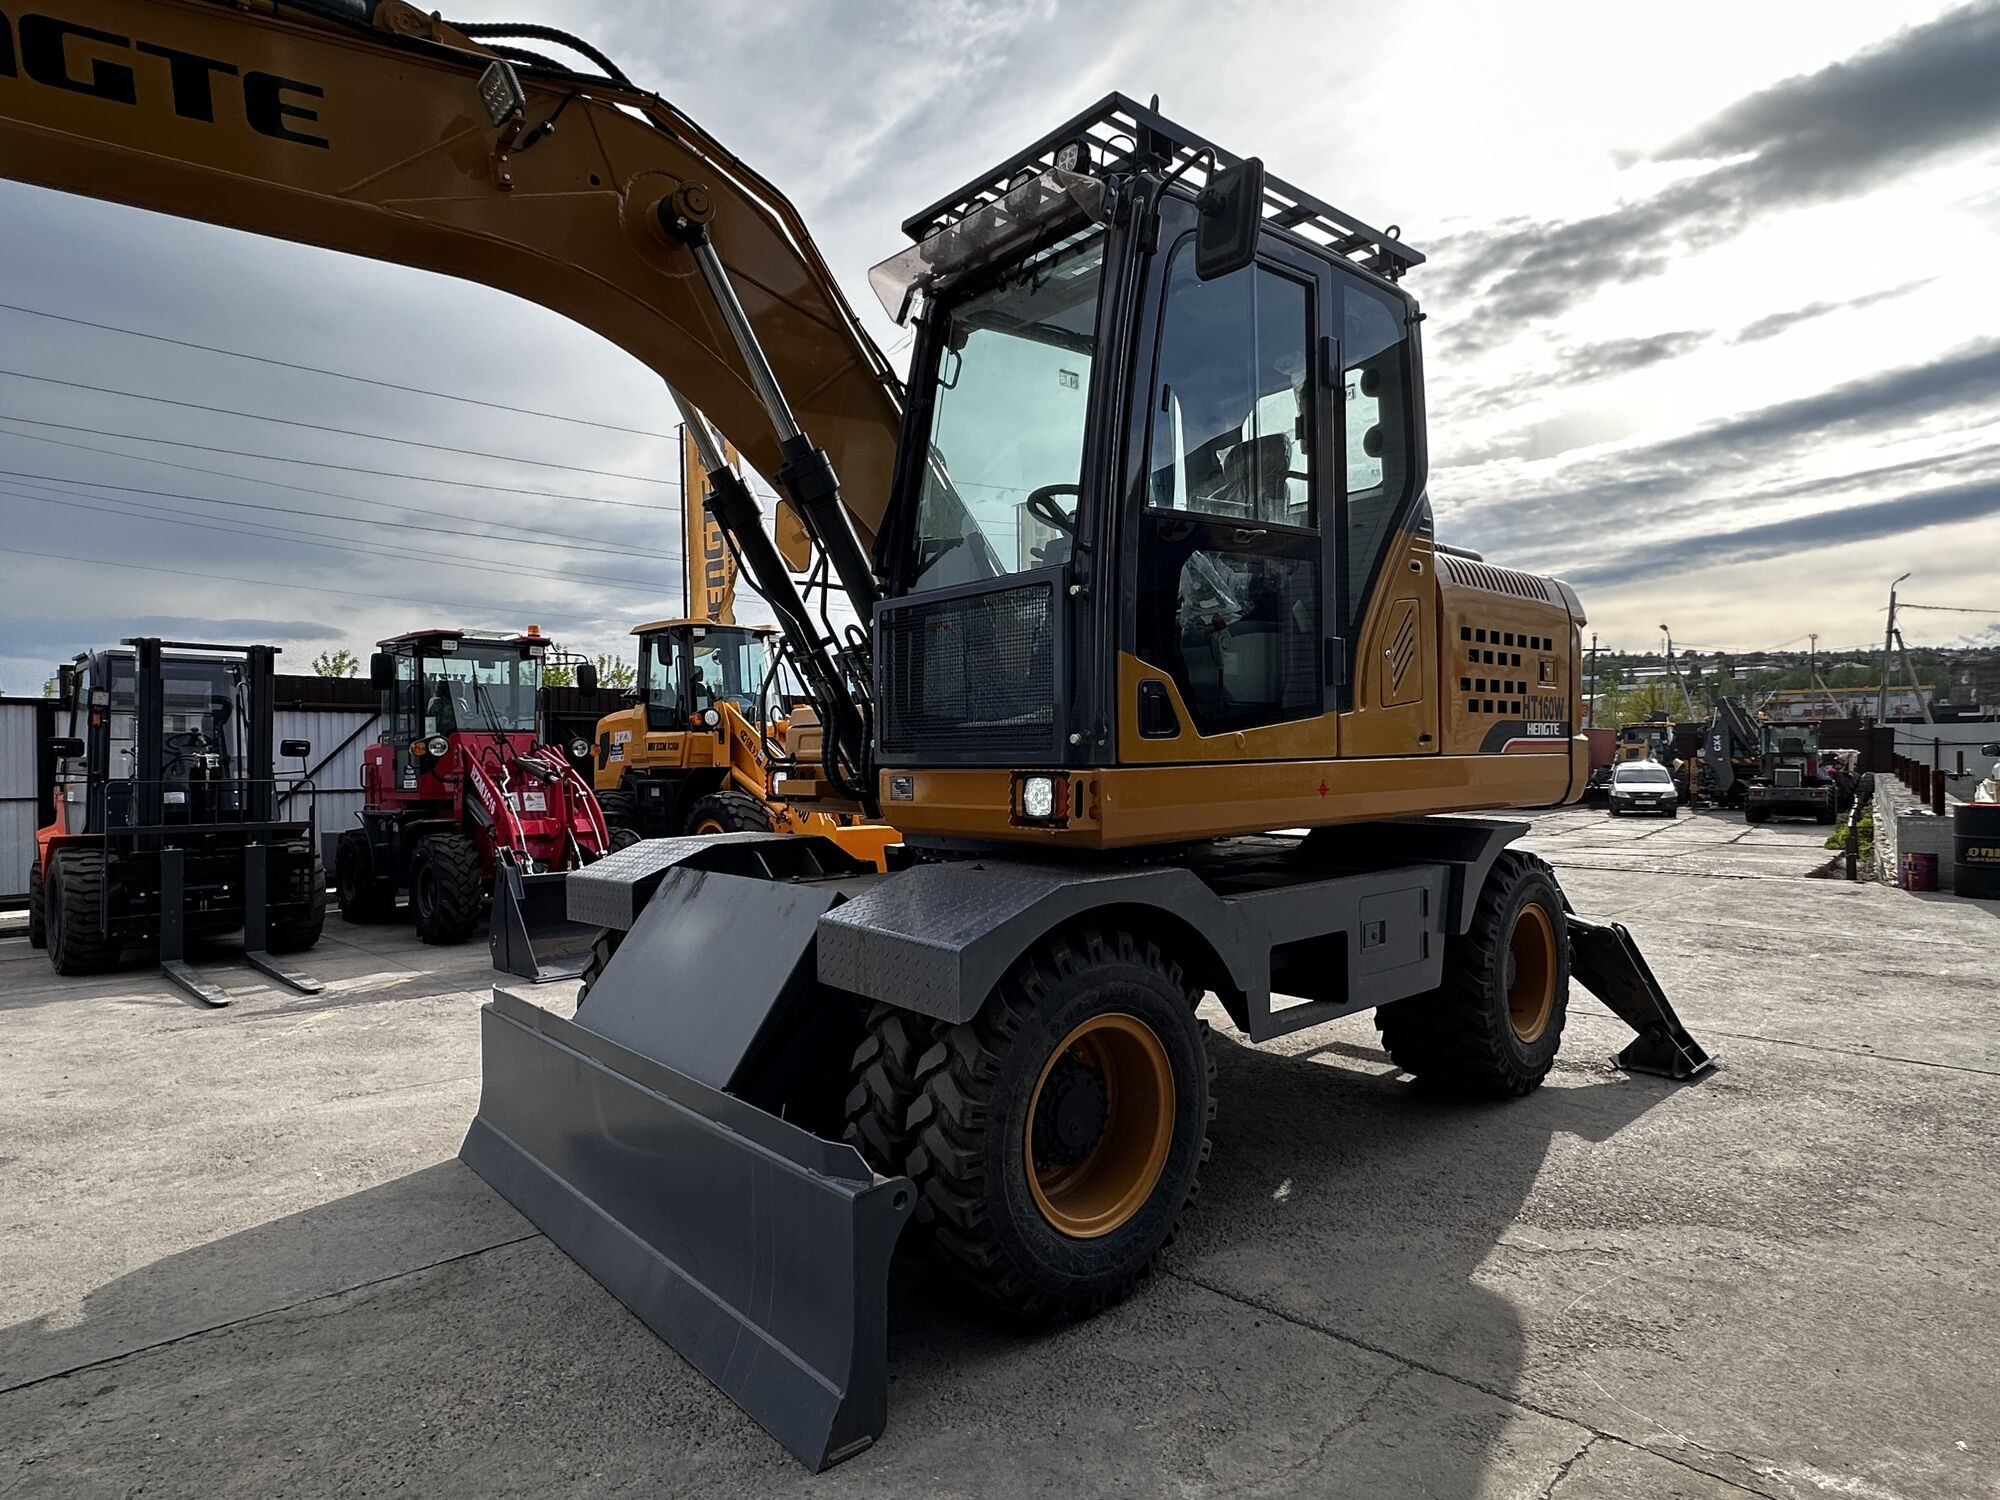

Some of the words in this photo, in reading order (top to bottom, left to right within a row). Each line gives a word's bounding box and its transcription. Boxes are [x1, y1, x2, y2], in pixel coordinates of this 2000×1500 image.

[0, 9, 330, 150] GTE
[1522, 695, 1565, 721] HT160W
[1526, 722, 1560, 736] HENGTE
